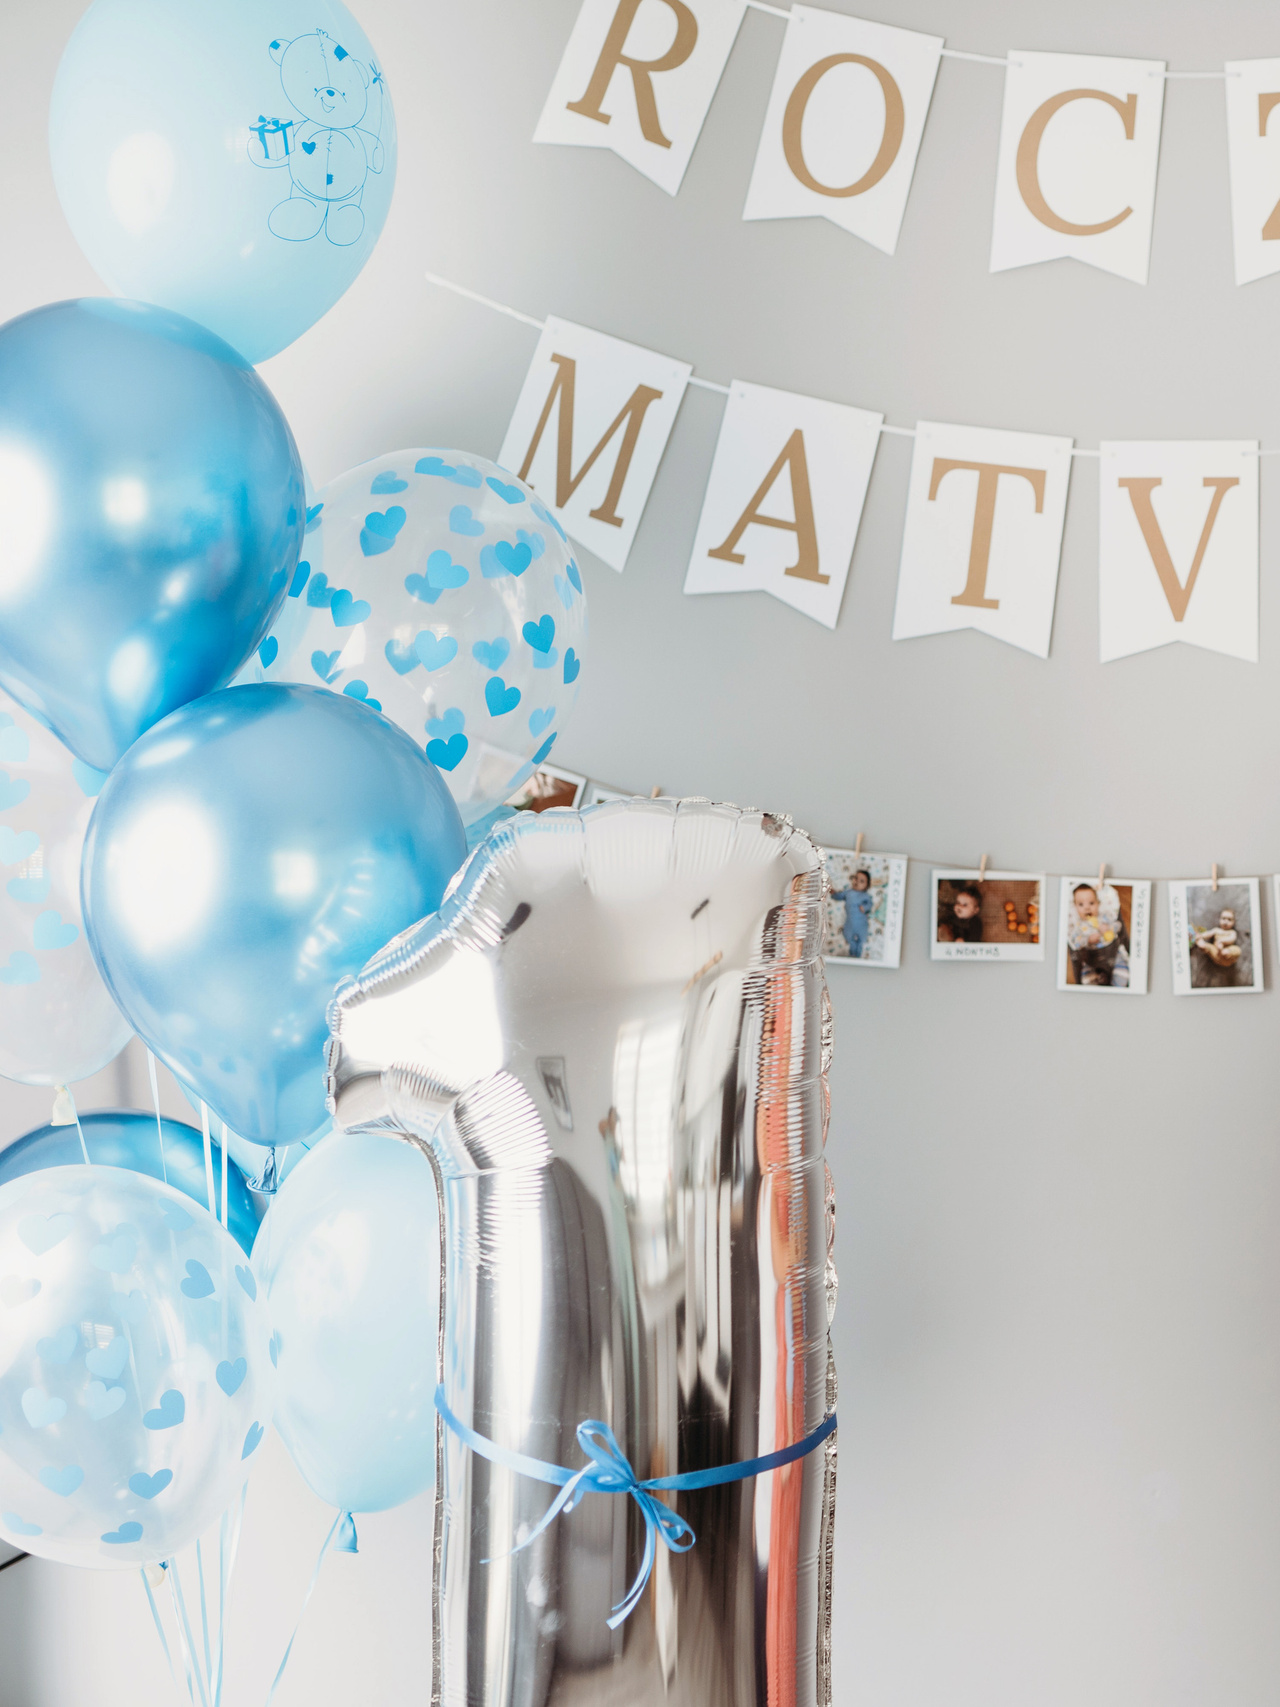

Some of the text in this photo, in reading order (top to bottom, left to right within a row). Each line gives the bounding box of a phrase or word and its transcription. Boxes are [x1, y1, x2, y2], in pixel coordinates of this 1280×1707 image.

[889, 879, 901, 941] MONTHS
[1135, 902, 1144, 958] MONTHS
[956, 946, 1001, 957] MONTHS
[1173, 911, 1185, 975] MONTHS
